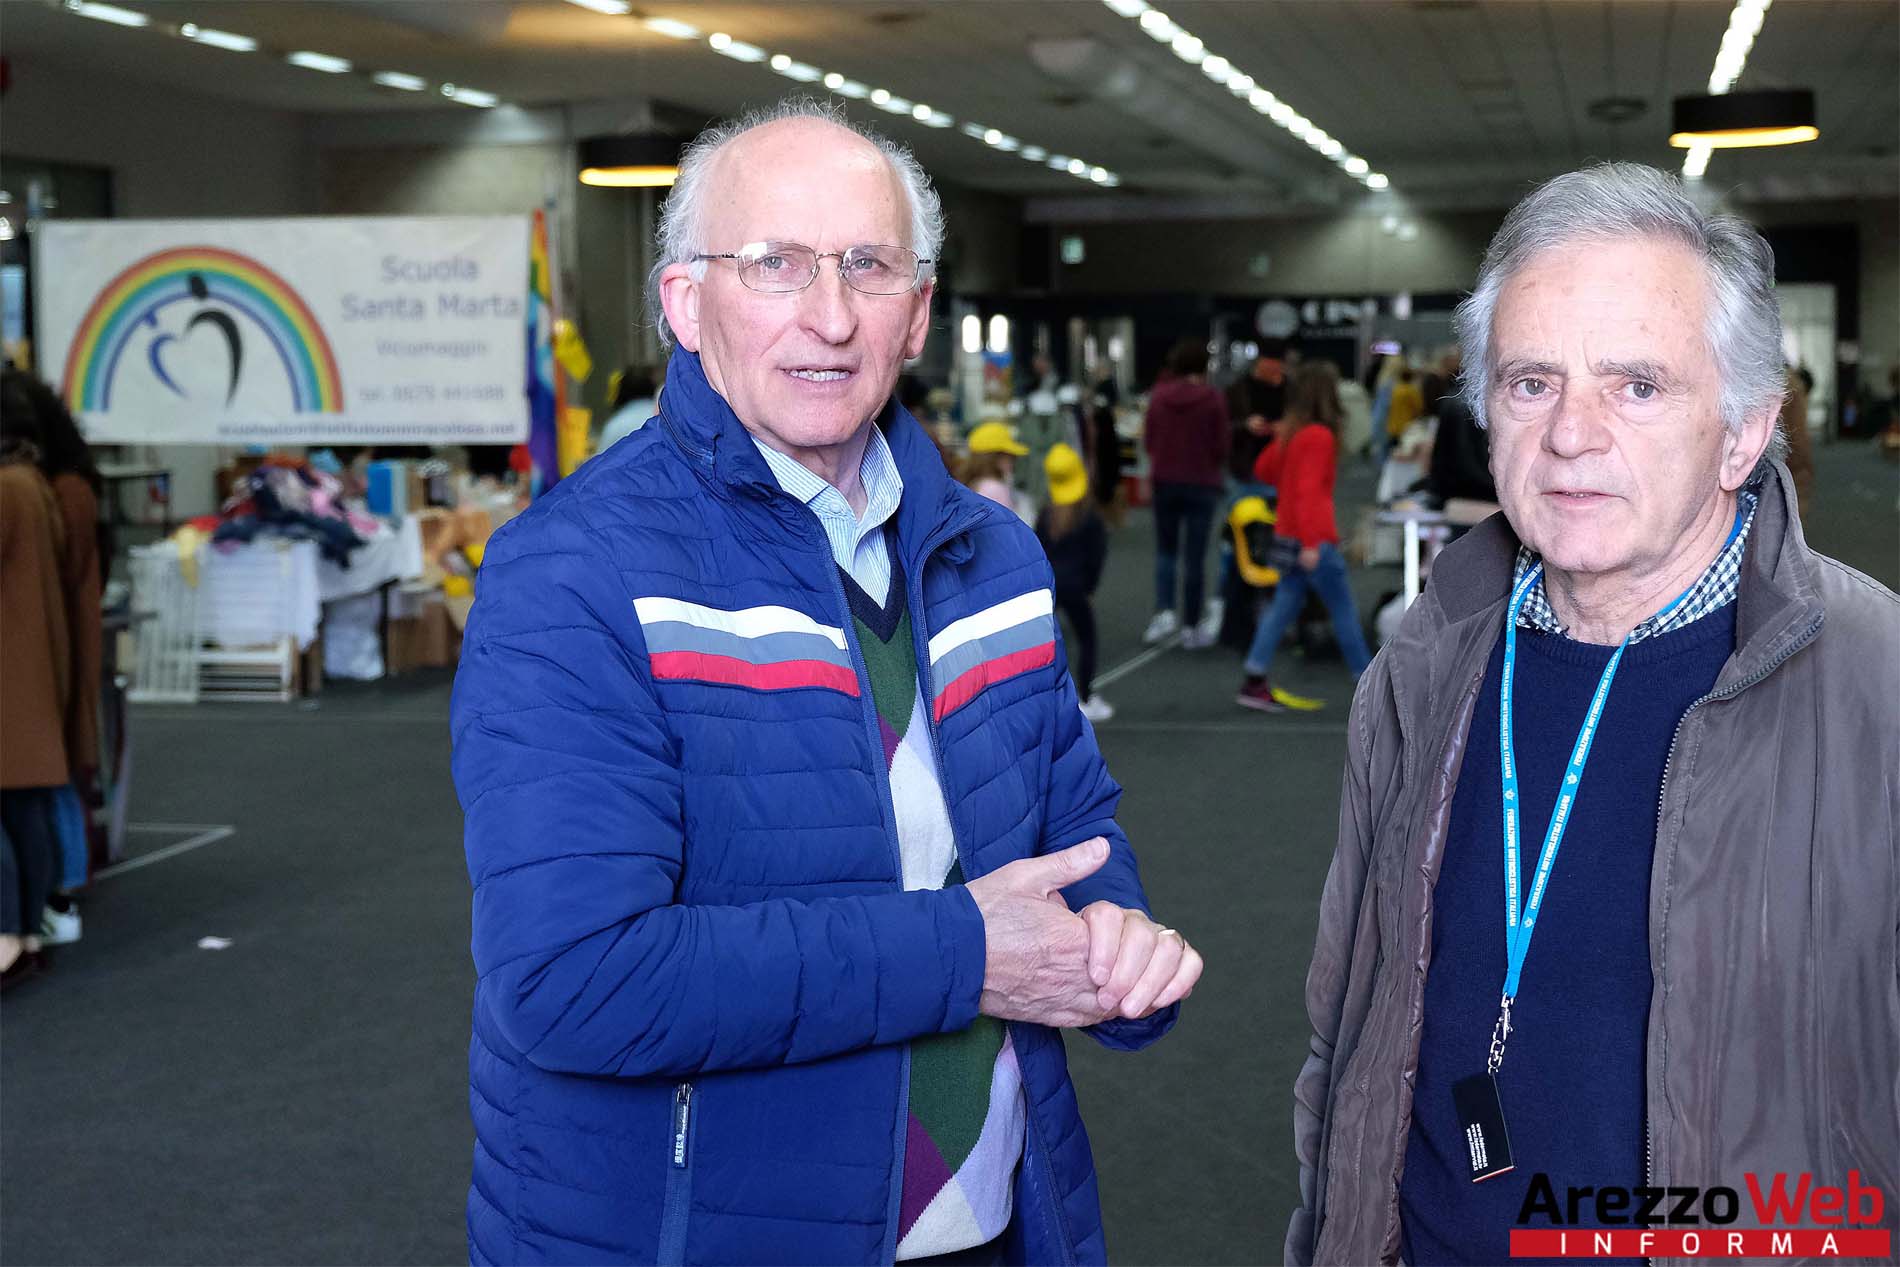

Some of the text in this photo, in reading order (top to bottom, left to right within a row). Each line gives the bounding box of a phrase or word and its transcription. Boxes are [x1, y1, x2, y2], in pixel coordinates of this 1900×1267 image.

[381, 254, 479, 283] Scuola
[341, 293, 522, 322] Santa Marta
